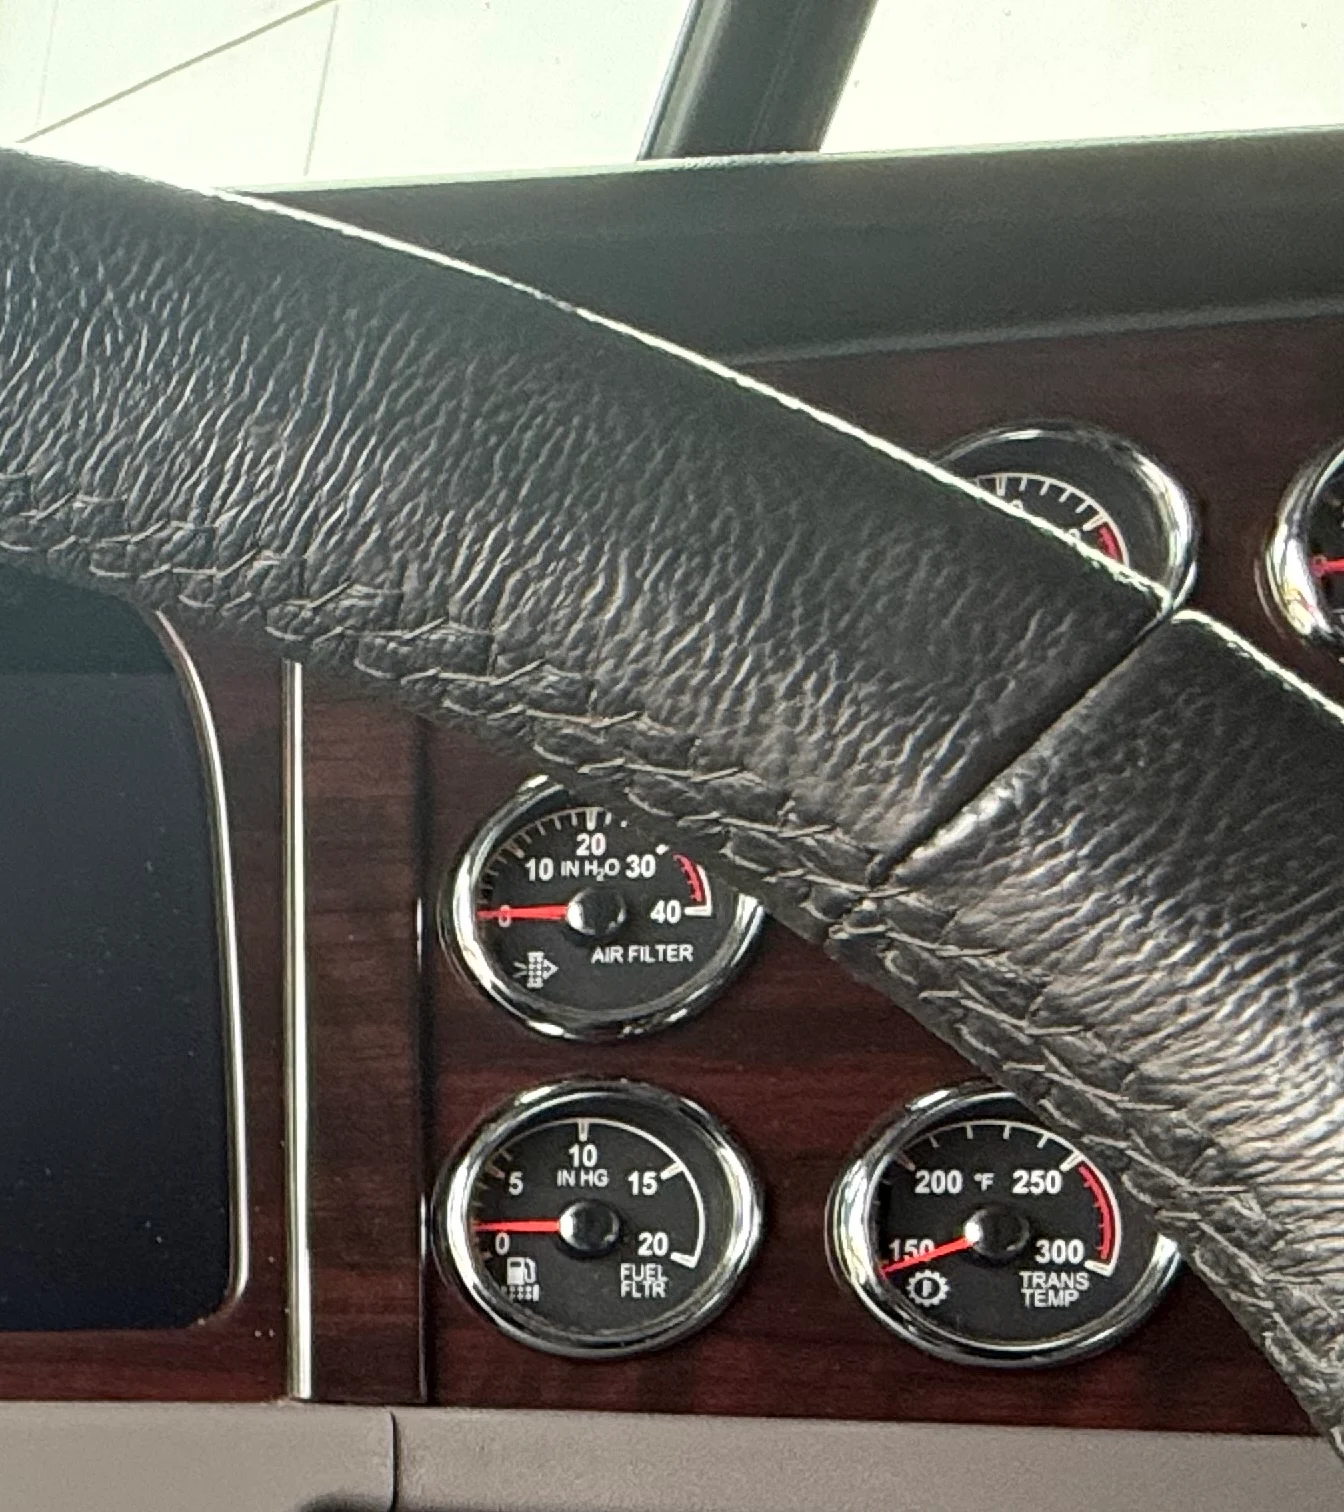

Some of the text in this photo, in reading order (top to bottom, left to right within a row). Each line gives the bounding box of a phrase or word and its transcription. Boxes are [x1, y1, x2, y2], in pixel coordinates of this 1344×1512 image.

[576, 832, 606, 856] 20
[525, 857, 554, 881] 10
[561, 860, 580, 876] IN
[625, 854, 656, 878] 30
[650, 899, 681, 924] 40
[591, 943, 694, 964] AIR FILTER
[568, 1145, 598, 1168] 10
[509, 1173, 524, 1196] 5
[557, 1169, 610, 1188] IN HG
[628, 1171, 658, 1196] 15
[914, 1170, 963, 1195] 200
[973, 1173, 995, 1192] °F
[1012, 1170, 1062, 1194] 250
[495, 1233, 510, 1256] 0
[638, 1232, 668, 1256] 20
[889, 1238, 936, 1262] 150
[1035, 1240, 1085, 1264] 300
[620, 1263, 668, 1282] FUEL
[1020, 1271, 1090, 1290] TRANS
[620, 1281, 666, 1298] FLTR
[1021, 1289, 1081, 1308] TEMP
